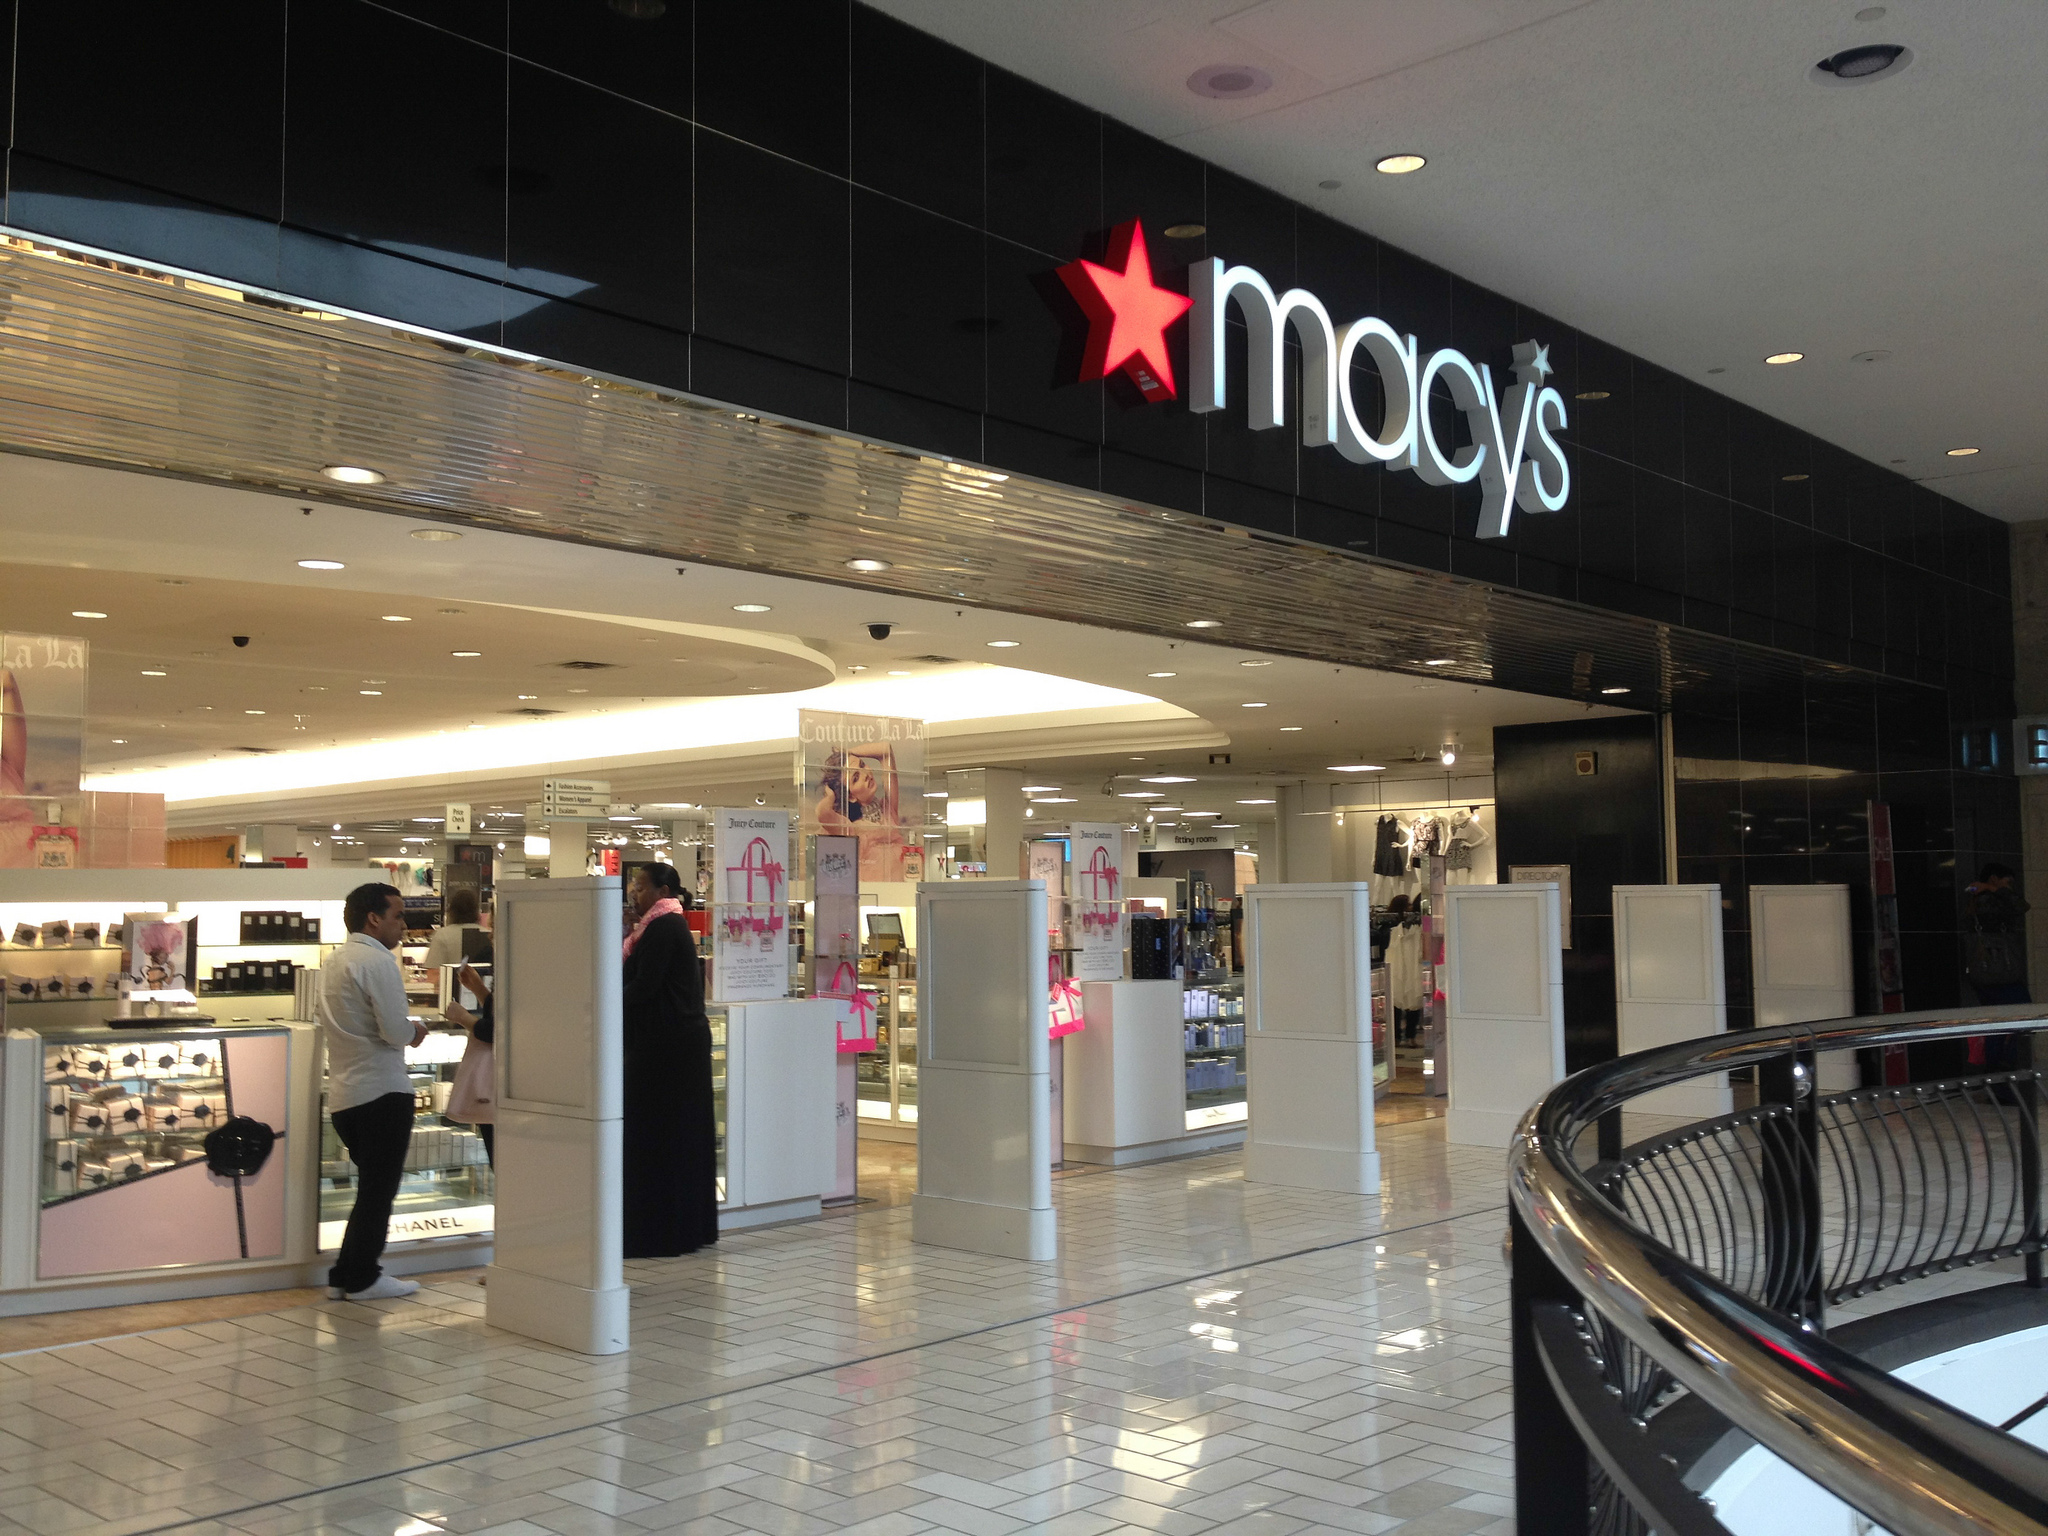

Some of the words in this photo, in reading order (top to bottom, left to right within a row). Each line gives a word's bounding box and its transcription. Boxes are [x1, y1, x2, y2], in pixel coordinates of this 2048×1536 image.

[37, 637, 84, 669] La
[799, 718, 875, 743] Couture
[876, 717, 901, 741] La
[902, 719, 924, 741] La
[728, 818, 747, 829] Juicy
[748, 819, 776, 829] Couture
[1175, 836, 1195, 845] fitting
[1517, 872, 1563, 881] DIRECTORY
